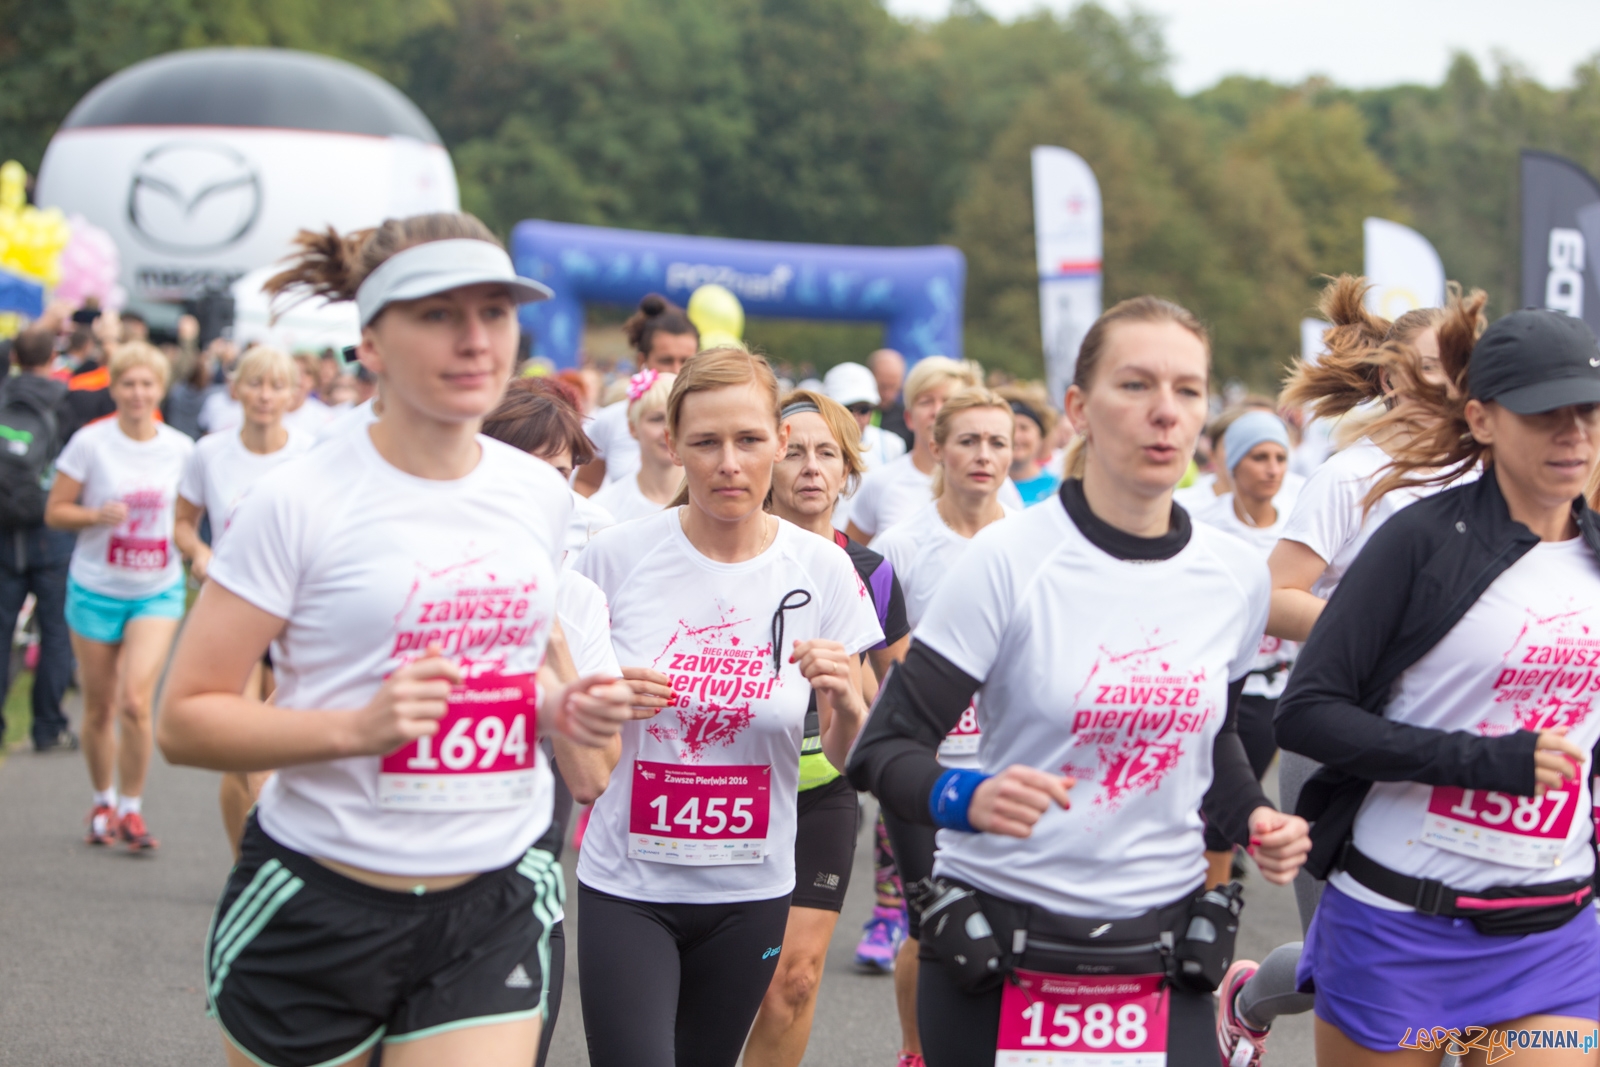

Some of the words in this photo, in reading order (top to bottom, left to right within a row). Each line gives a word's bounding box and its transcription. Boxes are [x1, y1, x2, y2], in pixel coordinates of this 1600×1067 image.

[417, 597, 530, 624] zawsze
[669, 653, 763, 677] zawsze
[702, 647, 722, 656] BIEG
[723, 648, 754, 658] KOBIET
[1093, 684, 1200, 707] zawsze
[406, 713, 529, 771] 1694
[664, 774, 694, 785] Zawsze
[695, 776, 728, 787] Pier(w)si
[728, 776, 748, 785] 2016
[649, 794, 754, 835] 1455
[1450, 788, 1570, 834] 1587
[1020, 1001, 1148, 1049] 1588
